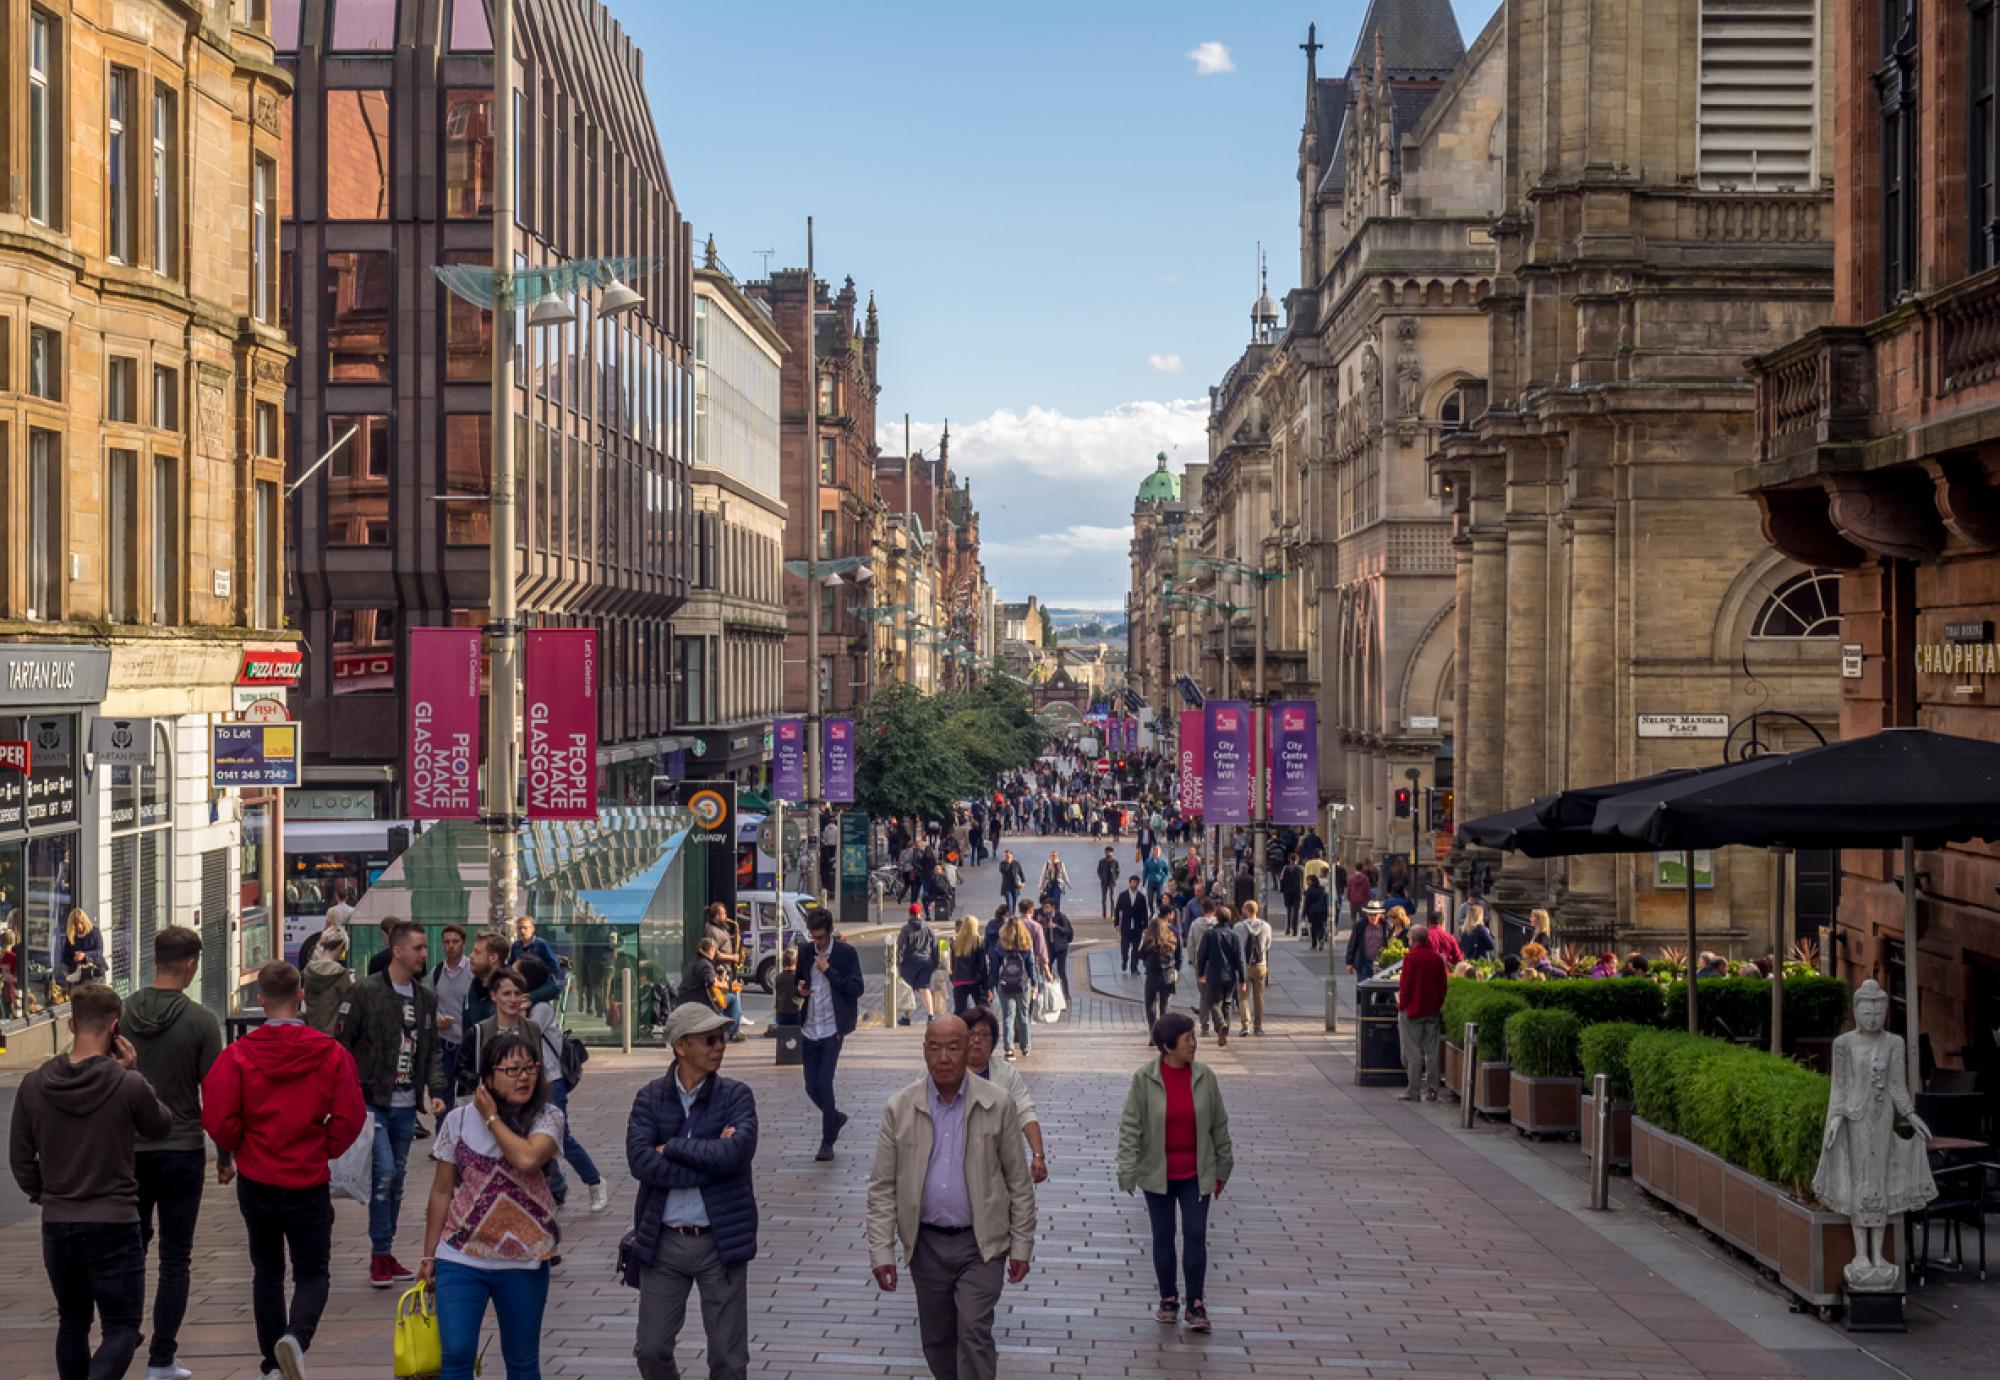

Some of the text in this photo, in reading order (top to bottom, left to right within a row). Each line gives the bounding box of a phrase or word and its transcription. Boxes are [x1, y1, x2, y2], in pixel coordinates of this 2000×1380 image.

[9, 661, 75, 689] TARTAN PLUS
[249, 661, 273, 677] PIZZA
[254, 705, 277, 715] FISH
[216, 727, 251, 739] To Let
[1218, 740, 1235, 751] City
[1286, 741, 1303, 751] City
[96, 751, 128, 761] TARTAN
[413, 702, 433, 809] GLASGOW
[530, 702, 549, 809] GLASGOW
[1213, 751, 1240, 760] Centre
[1281, 751, 1308, 760] Centre
[452, 732, 470, 809] PEOPLE
[569, 733, 588, 809] PEOPLE
[1217, 760, 1235, 770] Free
[1286, 761, 1304, 770] Free
[216, 769, 239, 780] 0141
[263, 769, 288, 780] 7342
[433, 749, 451, 809] MAKE
[550, 750, 569, 809] MAKE
[1182, 750, 1193, 809] GLASGOW
[1193, 776, 1203, 809] MAKE
[312, 796, 369, 809] LOOK
